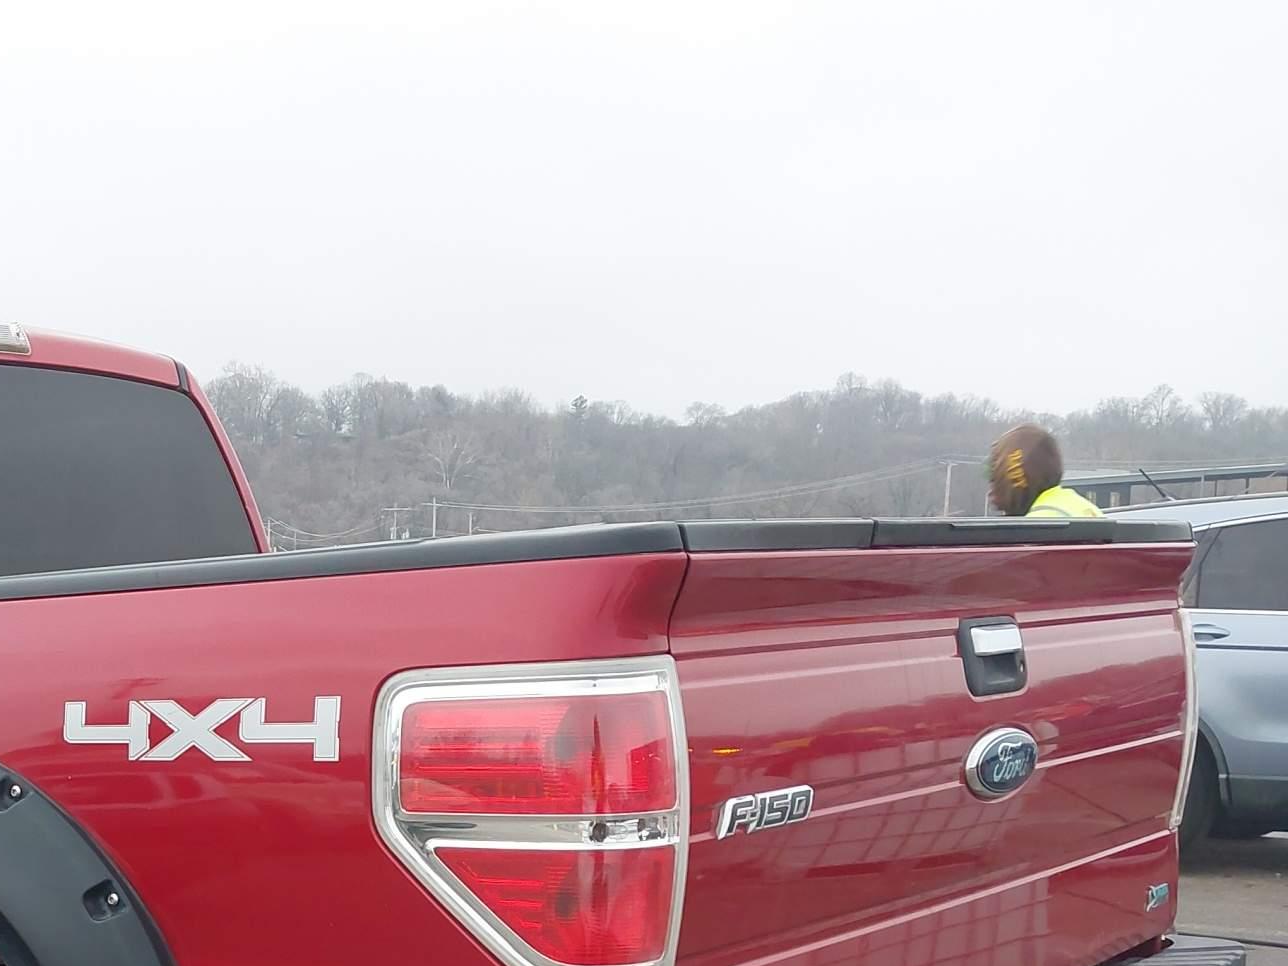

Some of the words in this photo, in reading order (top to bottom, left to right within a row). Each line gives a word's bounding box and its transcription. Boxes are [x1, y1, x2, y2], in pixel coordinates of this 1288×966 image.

[64, 696, 341, 762] 4X4
[993, 740, 1033, 783] Ford
[717, 785, 814, 840] F-150
